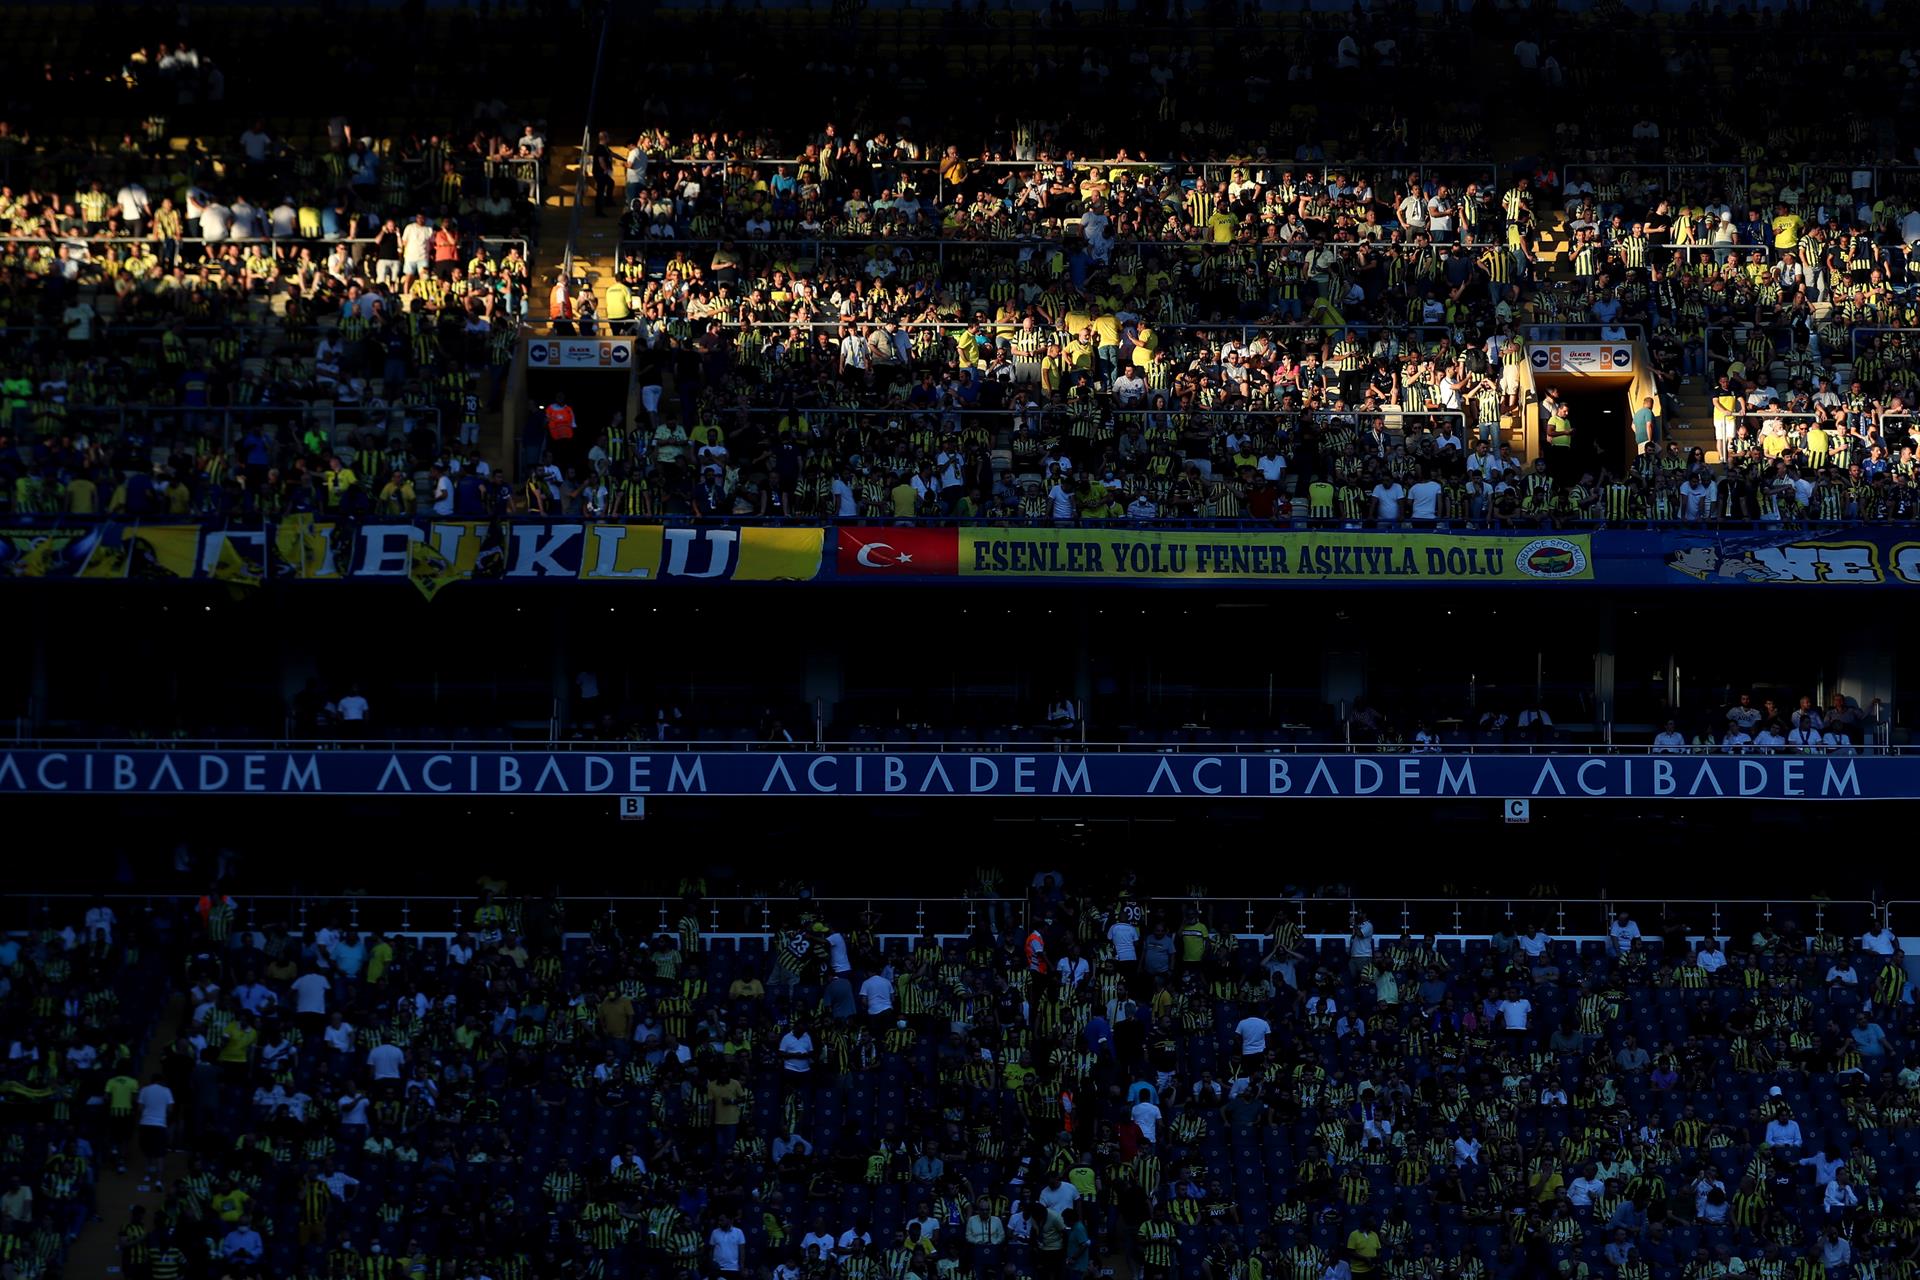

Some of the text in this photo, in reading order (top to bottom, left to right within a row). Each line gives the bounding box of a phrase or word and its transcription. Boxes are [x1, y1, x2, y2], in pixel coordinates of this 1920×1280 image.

[550, 347, 559, 358] B
[601, 347, 611, 358] C
[1550, 351, 1561, 363] C
[1601, 351, 1611, 363] D
[974, 541, 1505, 581] ESENLER YOLU FENER AŞKIYLA DOLU
[0, 754, 1861, 796] ACIBADEM ACIBADEM ACIBADEM ACIBADEM ACIBADEM
[627, 798, 638, 813] B
[1511, 801, 1523, 816] C
[789, 934, 811, 954] 23
